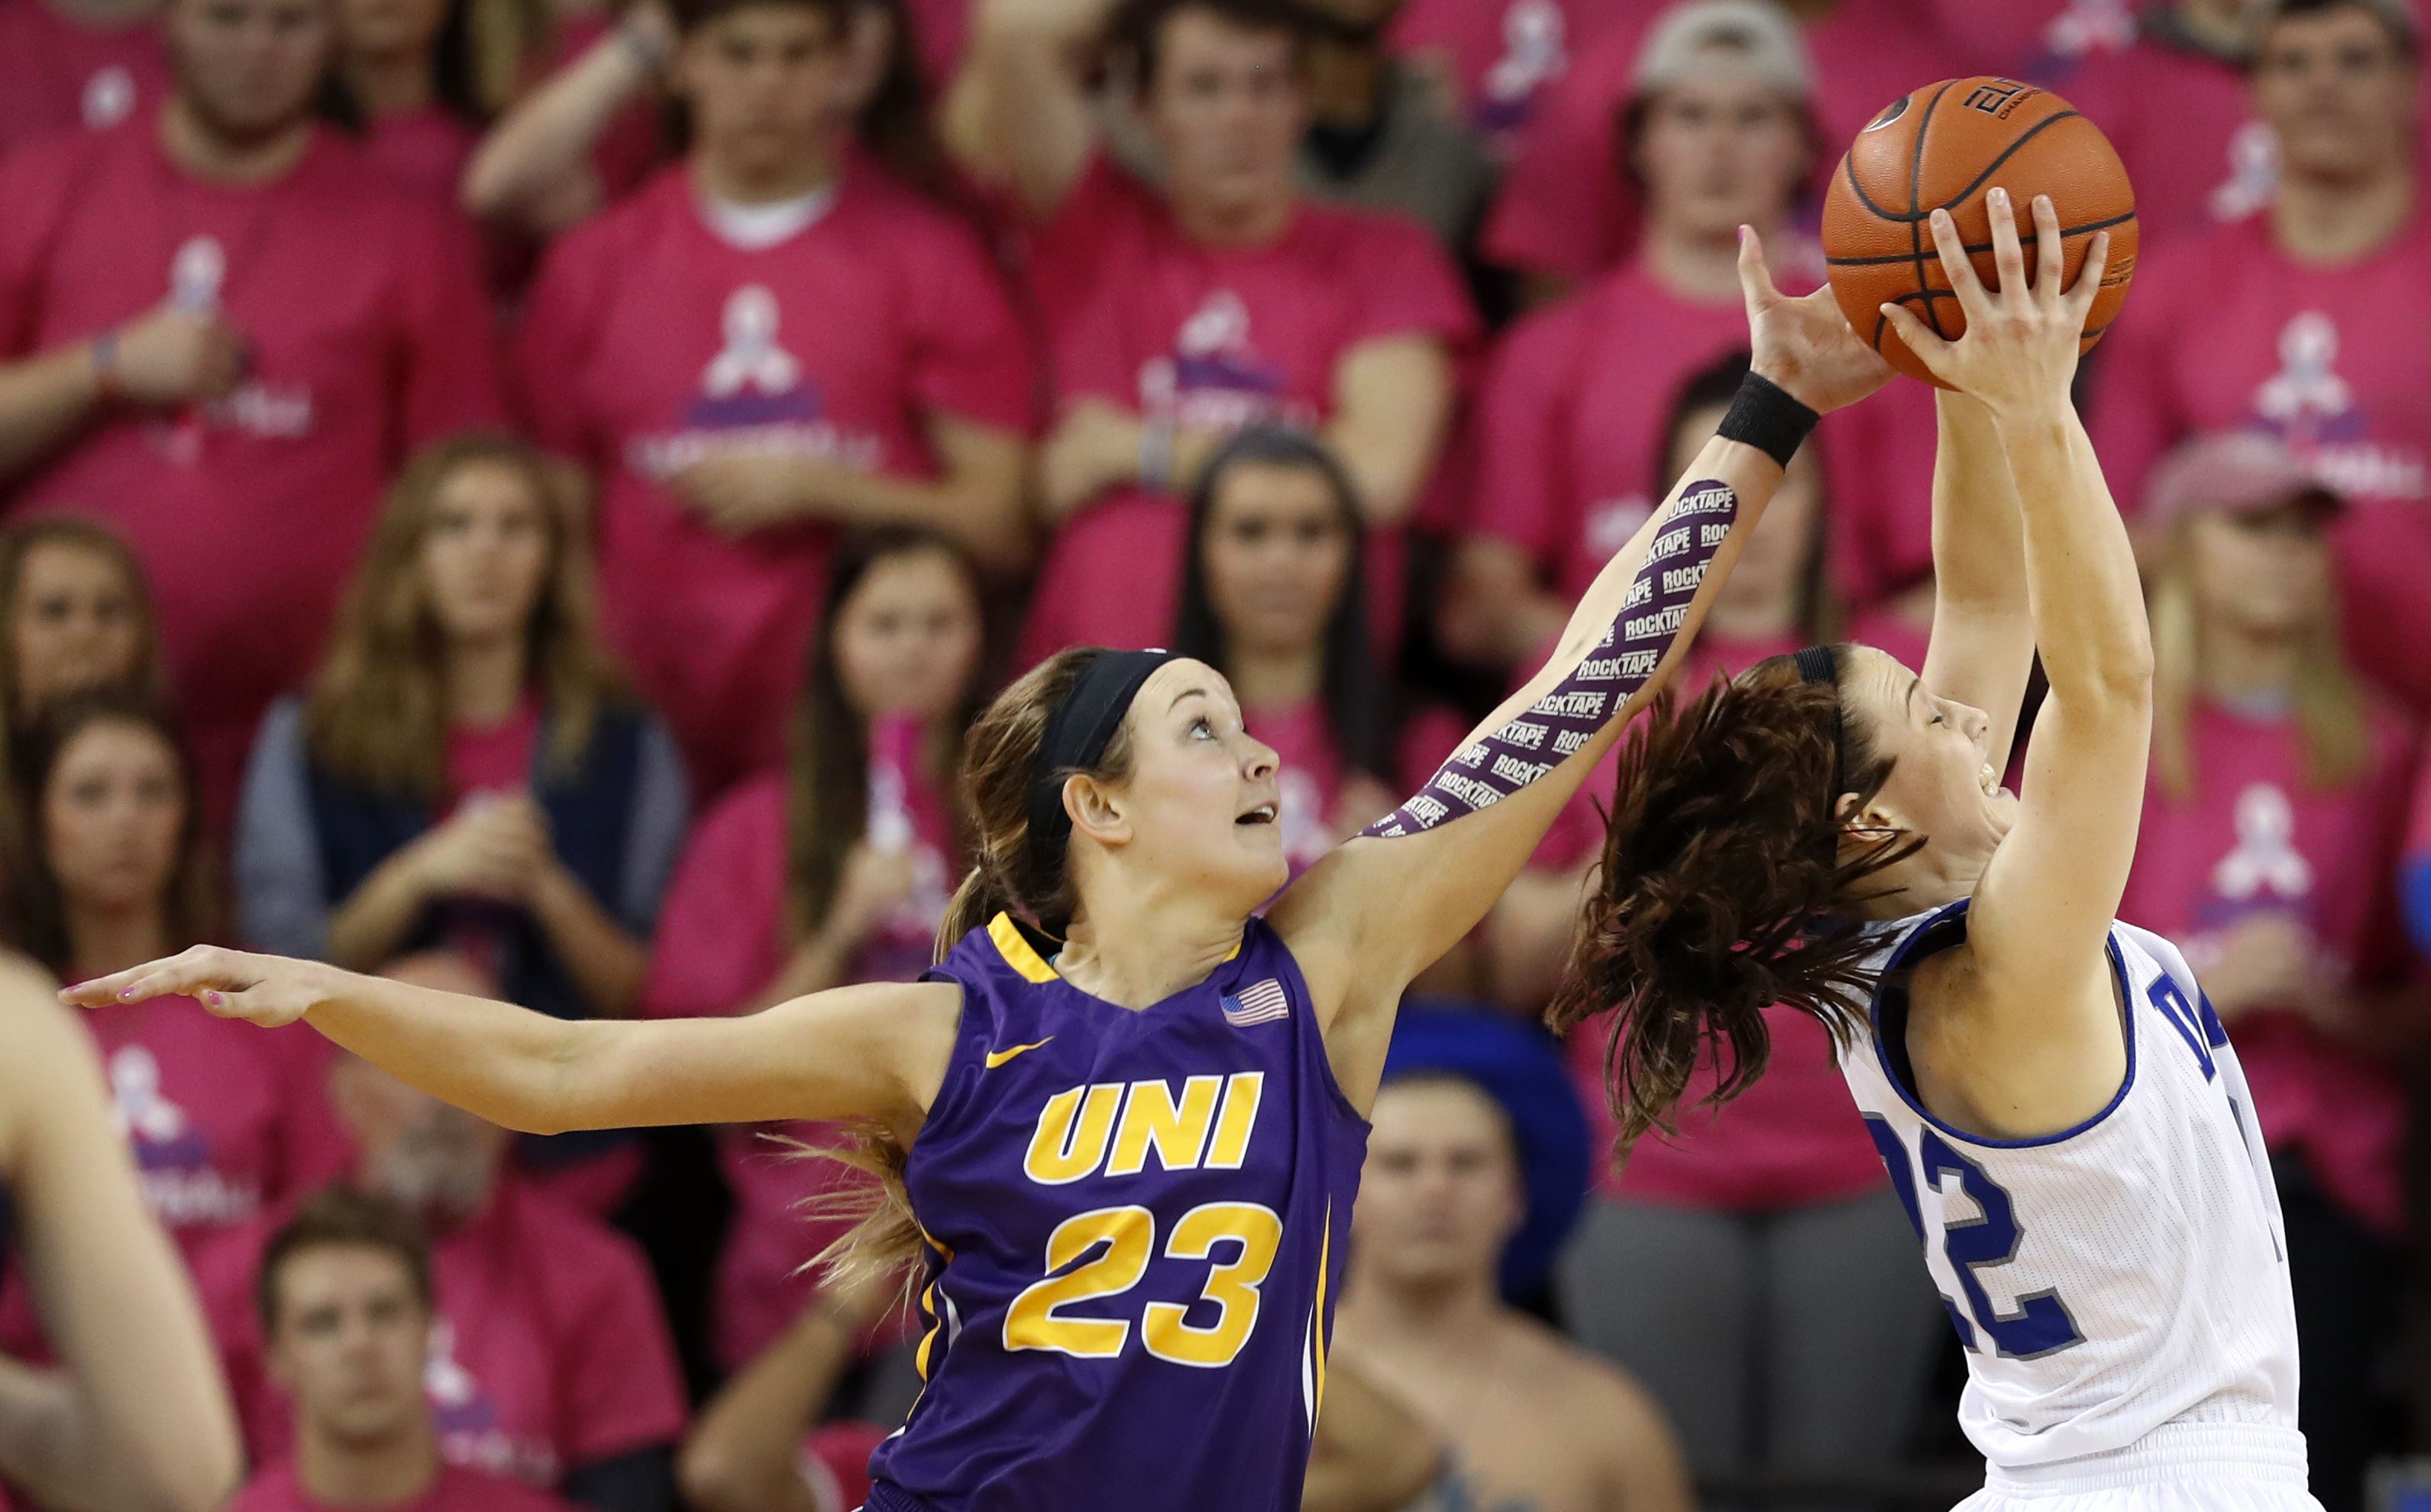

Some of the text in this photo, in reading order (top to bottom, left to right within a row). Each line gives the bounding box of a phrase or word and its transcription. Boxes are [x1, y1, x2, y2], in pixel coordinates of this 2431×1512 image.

[1577, 654, 1657, 677] ROCKTAPE
[1553, 729, 1593, 751] ROC
[1023, 1071, 1265, 1185] UNI
[1002, 1201, 1283, 1368] 23
